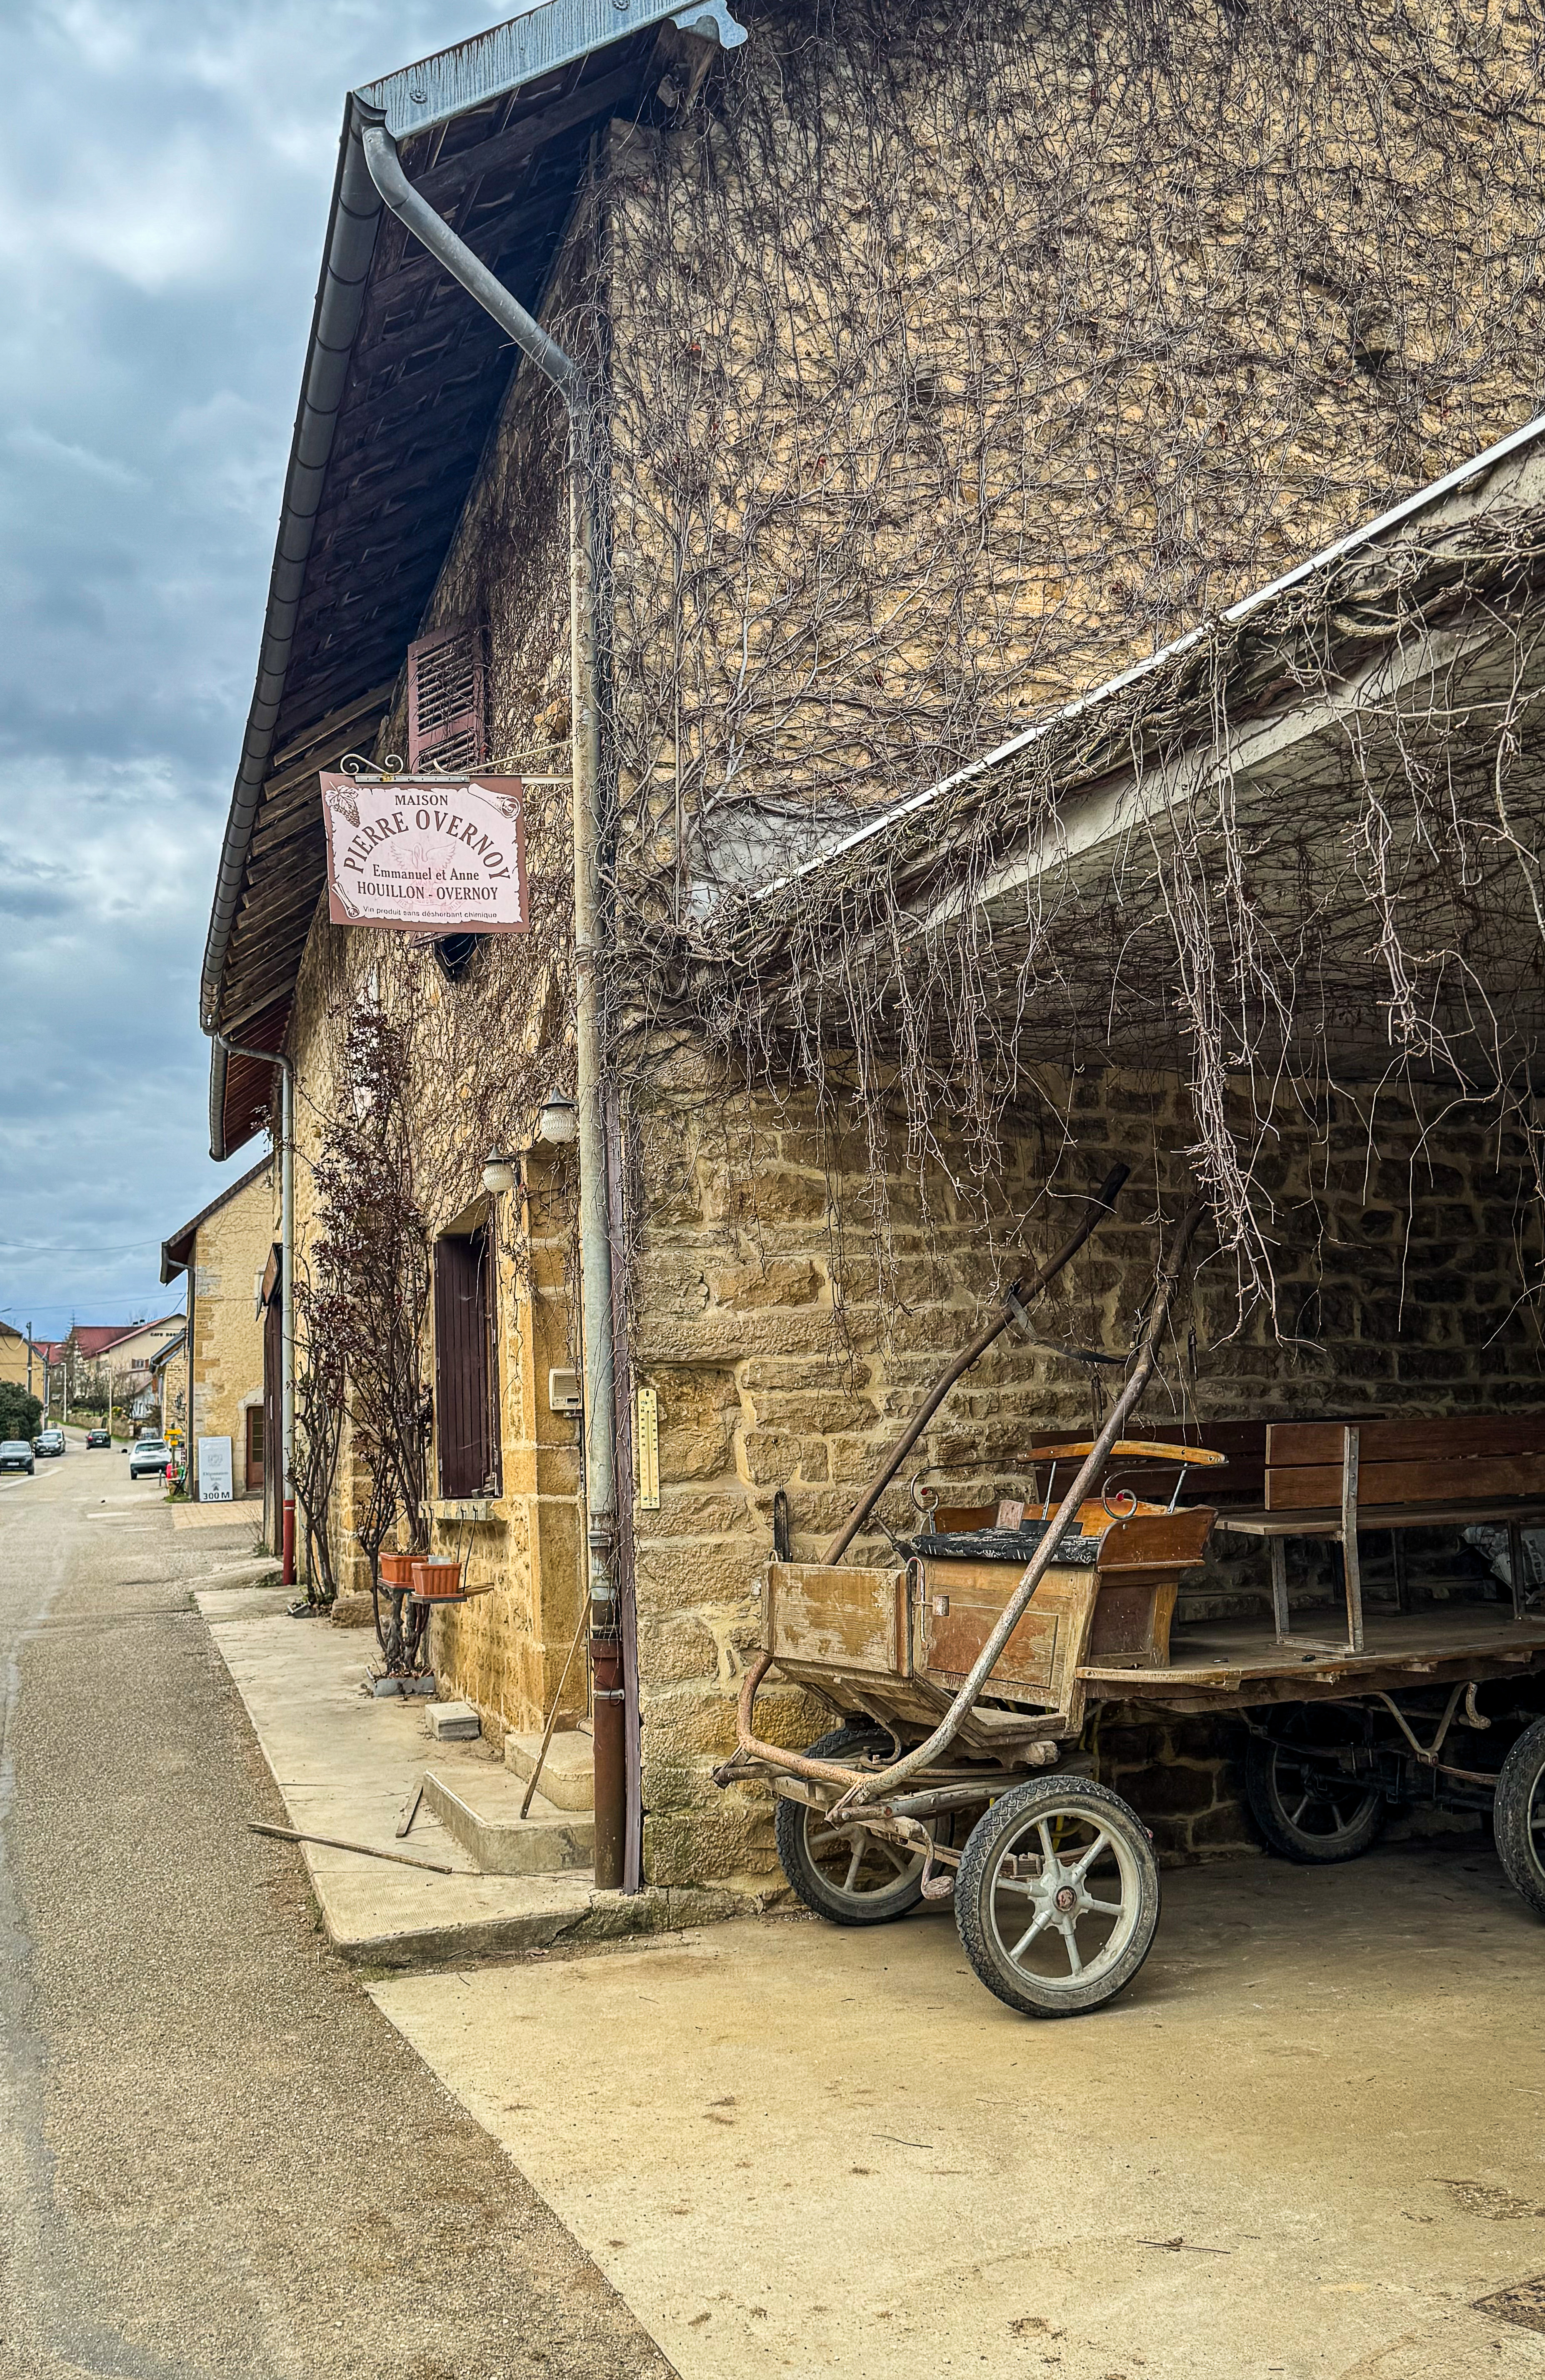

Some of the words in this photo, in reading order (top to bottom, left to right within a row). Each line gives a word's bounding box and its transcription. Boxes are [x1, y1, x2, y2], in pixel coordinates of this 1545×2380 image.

[395, 795, 448, 805] MAISON
[344, 812, 409, 874] PIERRE
[416, 810, 510, 879] OVERNOY
[373, 864, 432, 880] Emmanuel
[435, 870, 447, 880] et
[450, 868, 479, 880] Anne
[357, 881, 424, 899] HOUILLON
[437, 887, 498, 900] OVERNOY
